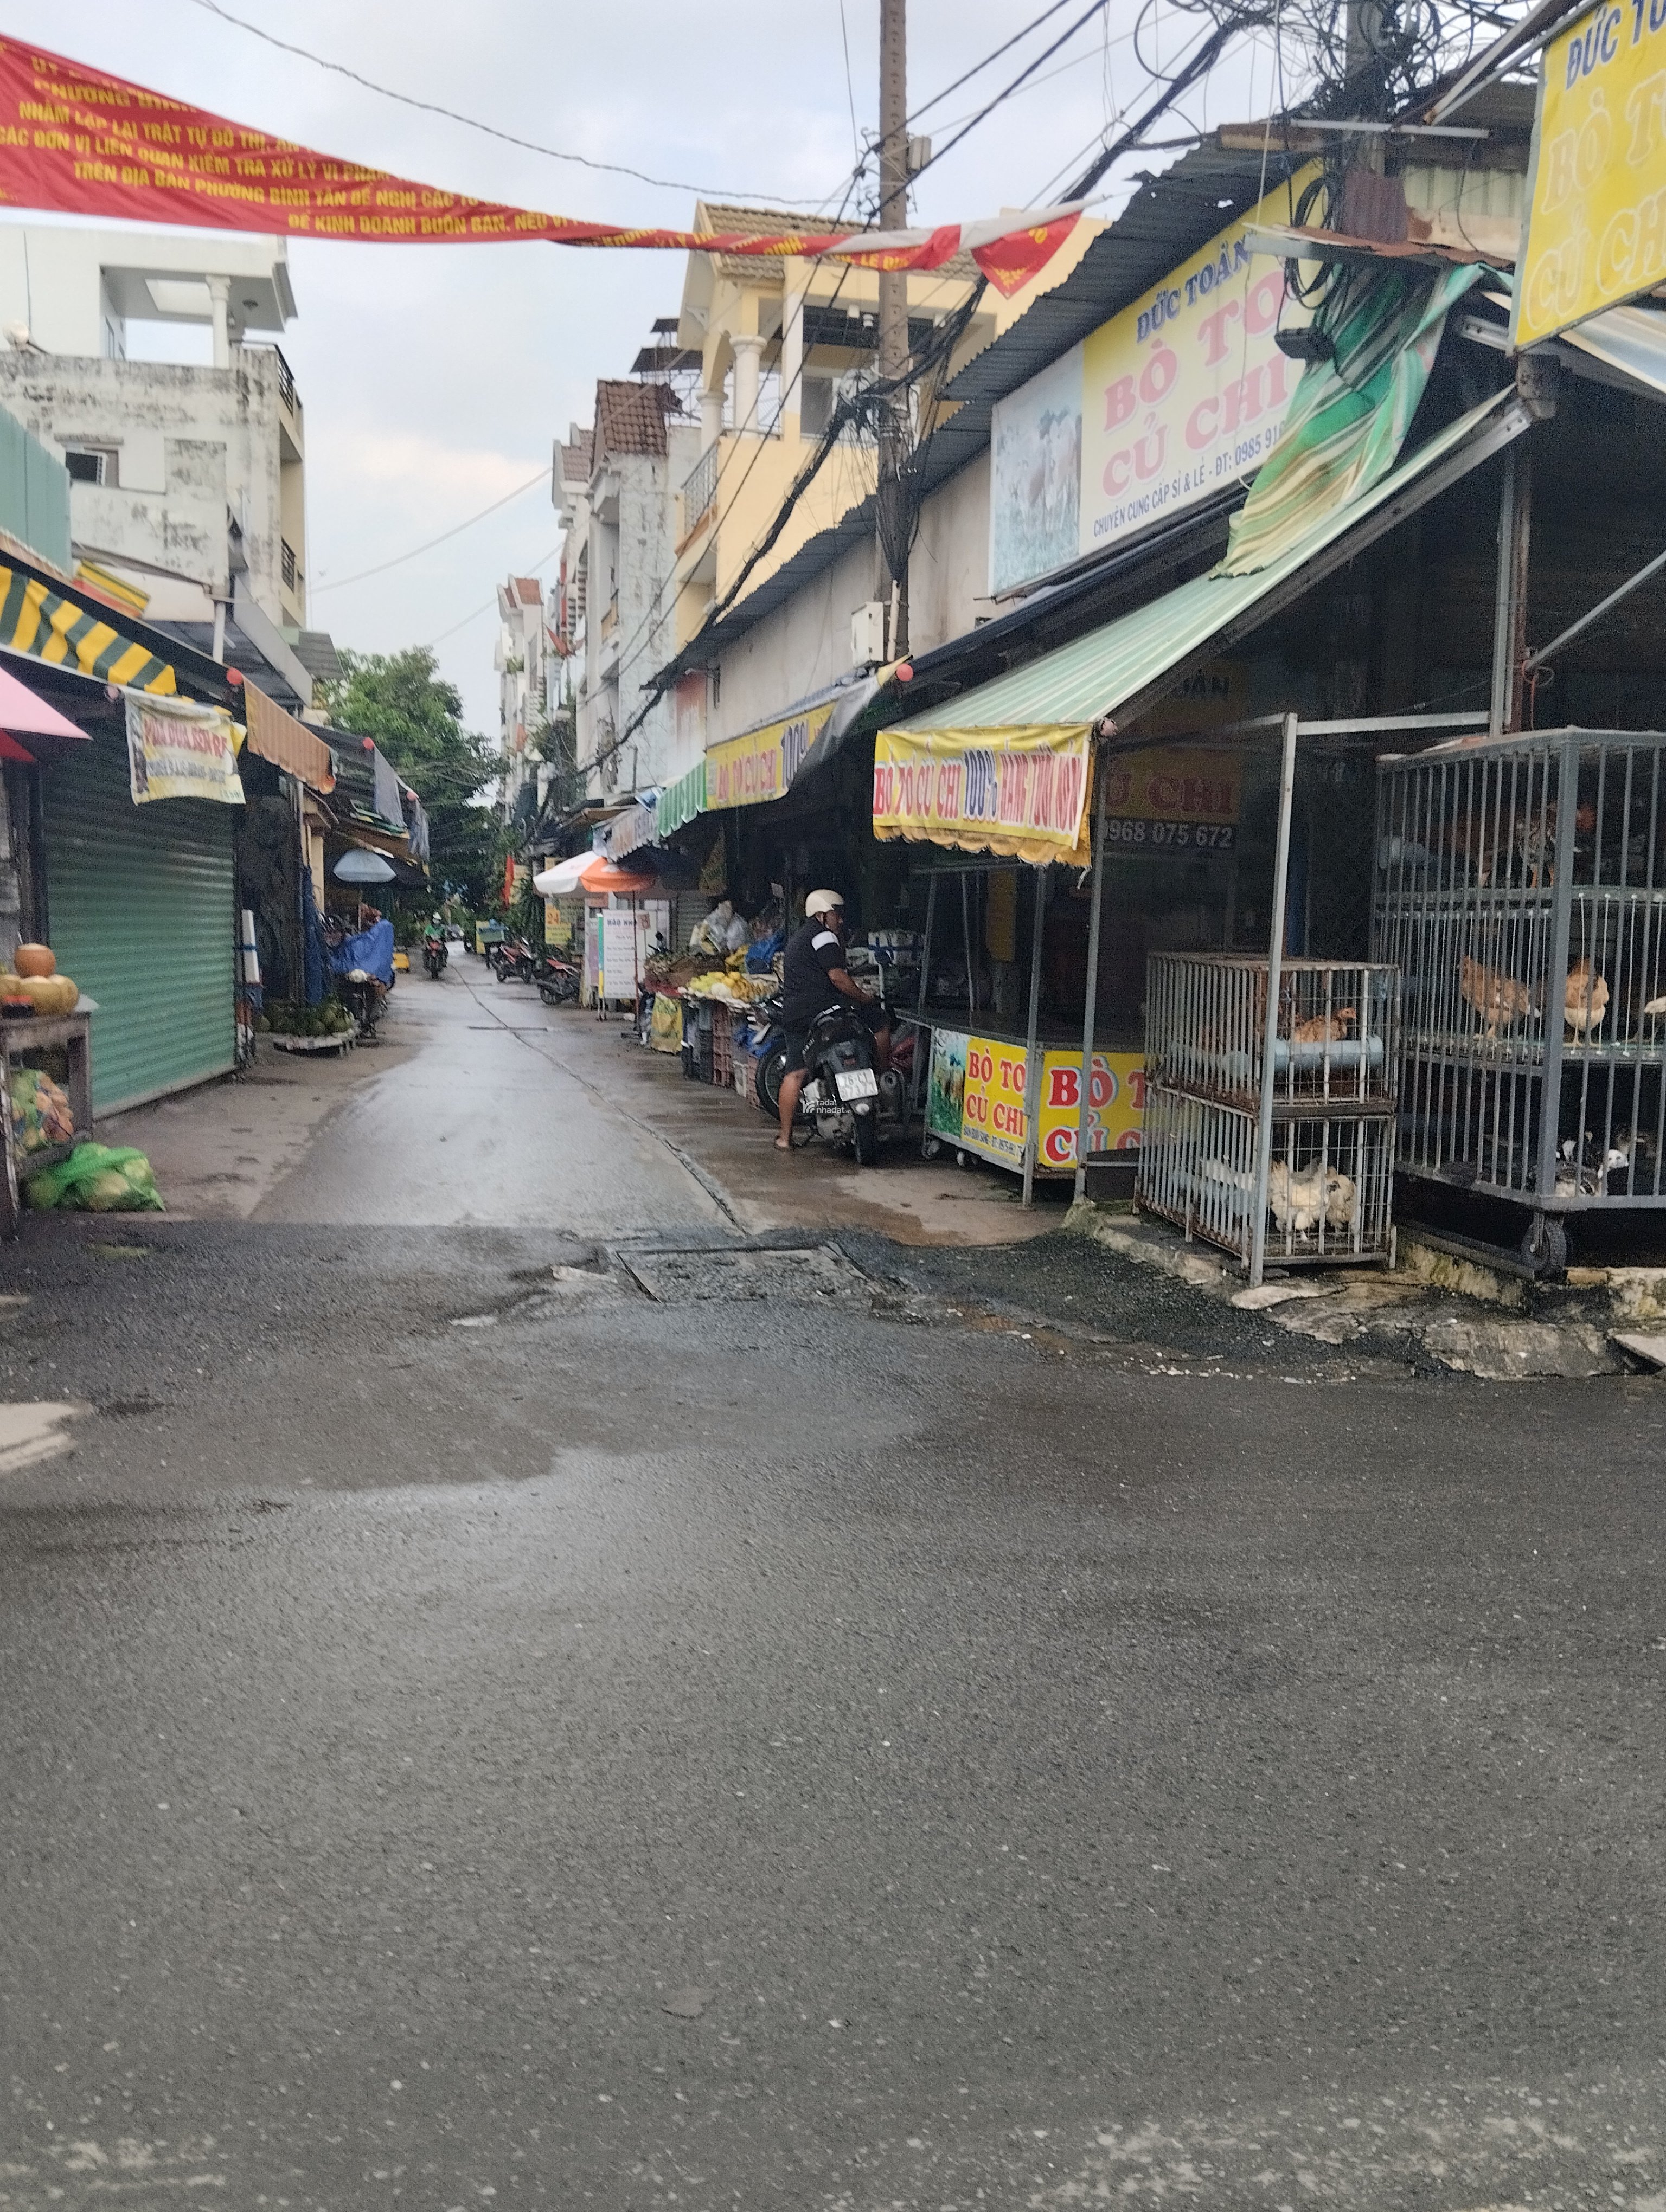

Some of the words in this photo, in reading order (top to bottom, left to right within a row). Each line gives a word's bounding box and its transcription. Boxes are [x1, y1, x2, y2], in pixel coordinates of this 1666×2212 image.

[1566, 4, 1622, 91] ĐỨC
[234, 157, 266, 178] TRA
[1541, 88, 1612, 214] BÒ
[315, 215, 355, 233] KINH
[360, 215, 416, 234] DOANH
[421, 214, 467, 234] BUÔN
[1137, 288, 1181, 344] ĐỨC
[1104, 339, 1179, 432] BÒ
[1102, 411, 1168, 497] CỦ
[1185, 352, 1289, 451] CHI
[1127, 494, 1150, 522] CUNG
[1183, 472, 1191, 493] &
[1234, 434, 1262, 466] 0985
[937, 762, 962, 819] CHI
[1152, 823, 1189, 846] 075
[1195, 825, 1233, 850] 672
[969, 1047, 993, 1082] BÒ
[1047, 1058, 1113, 1107] BÒ
[966, 1085, 989, 1123] CỦ
[993, 1104, 1024, 1137] CHI
